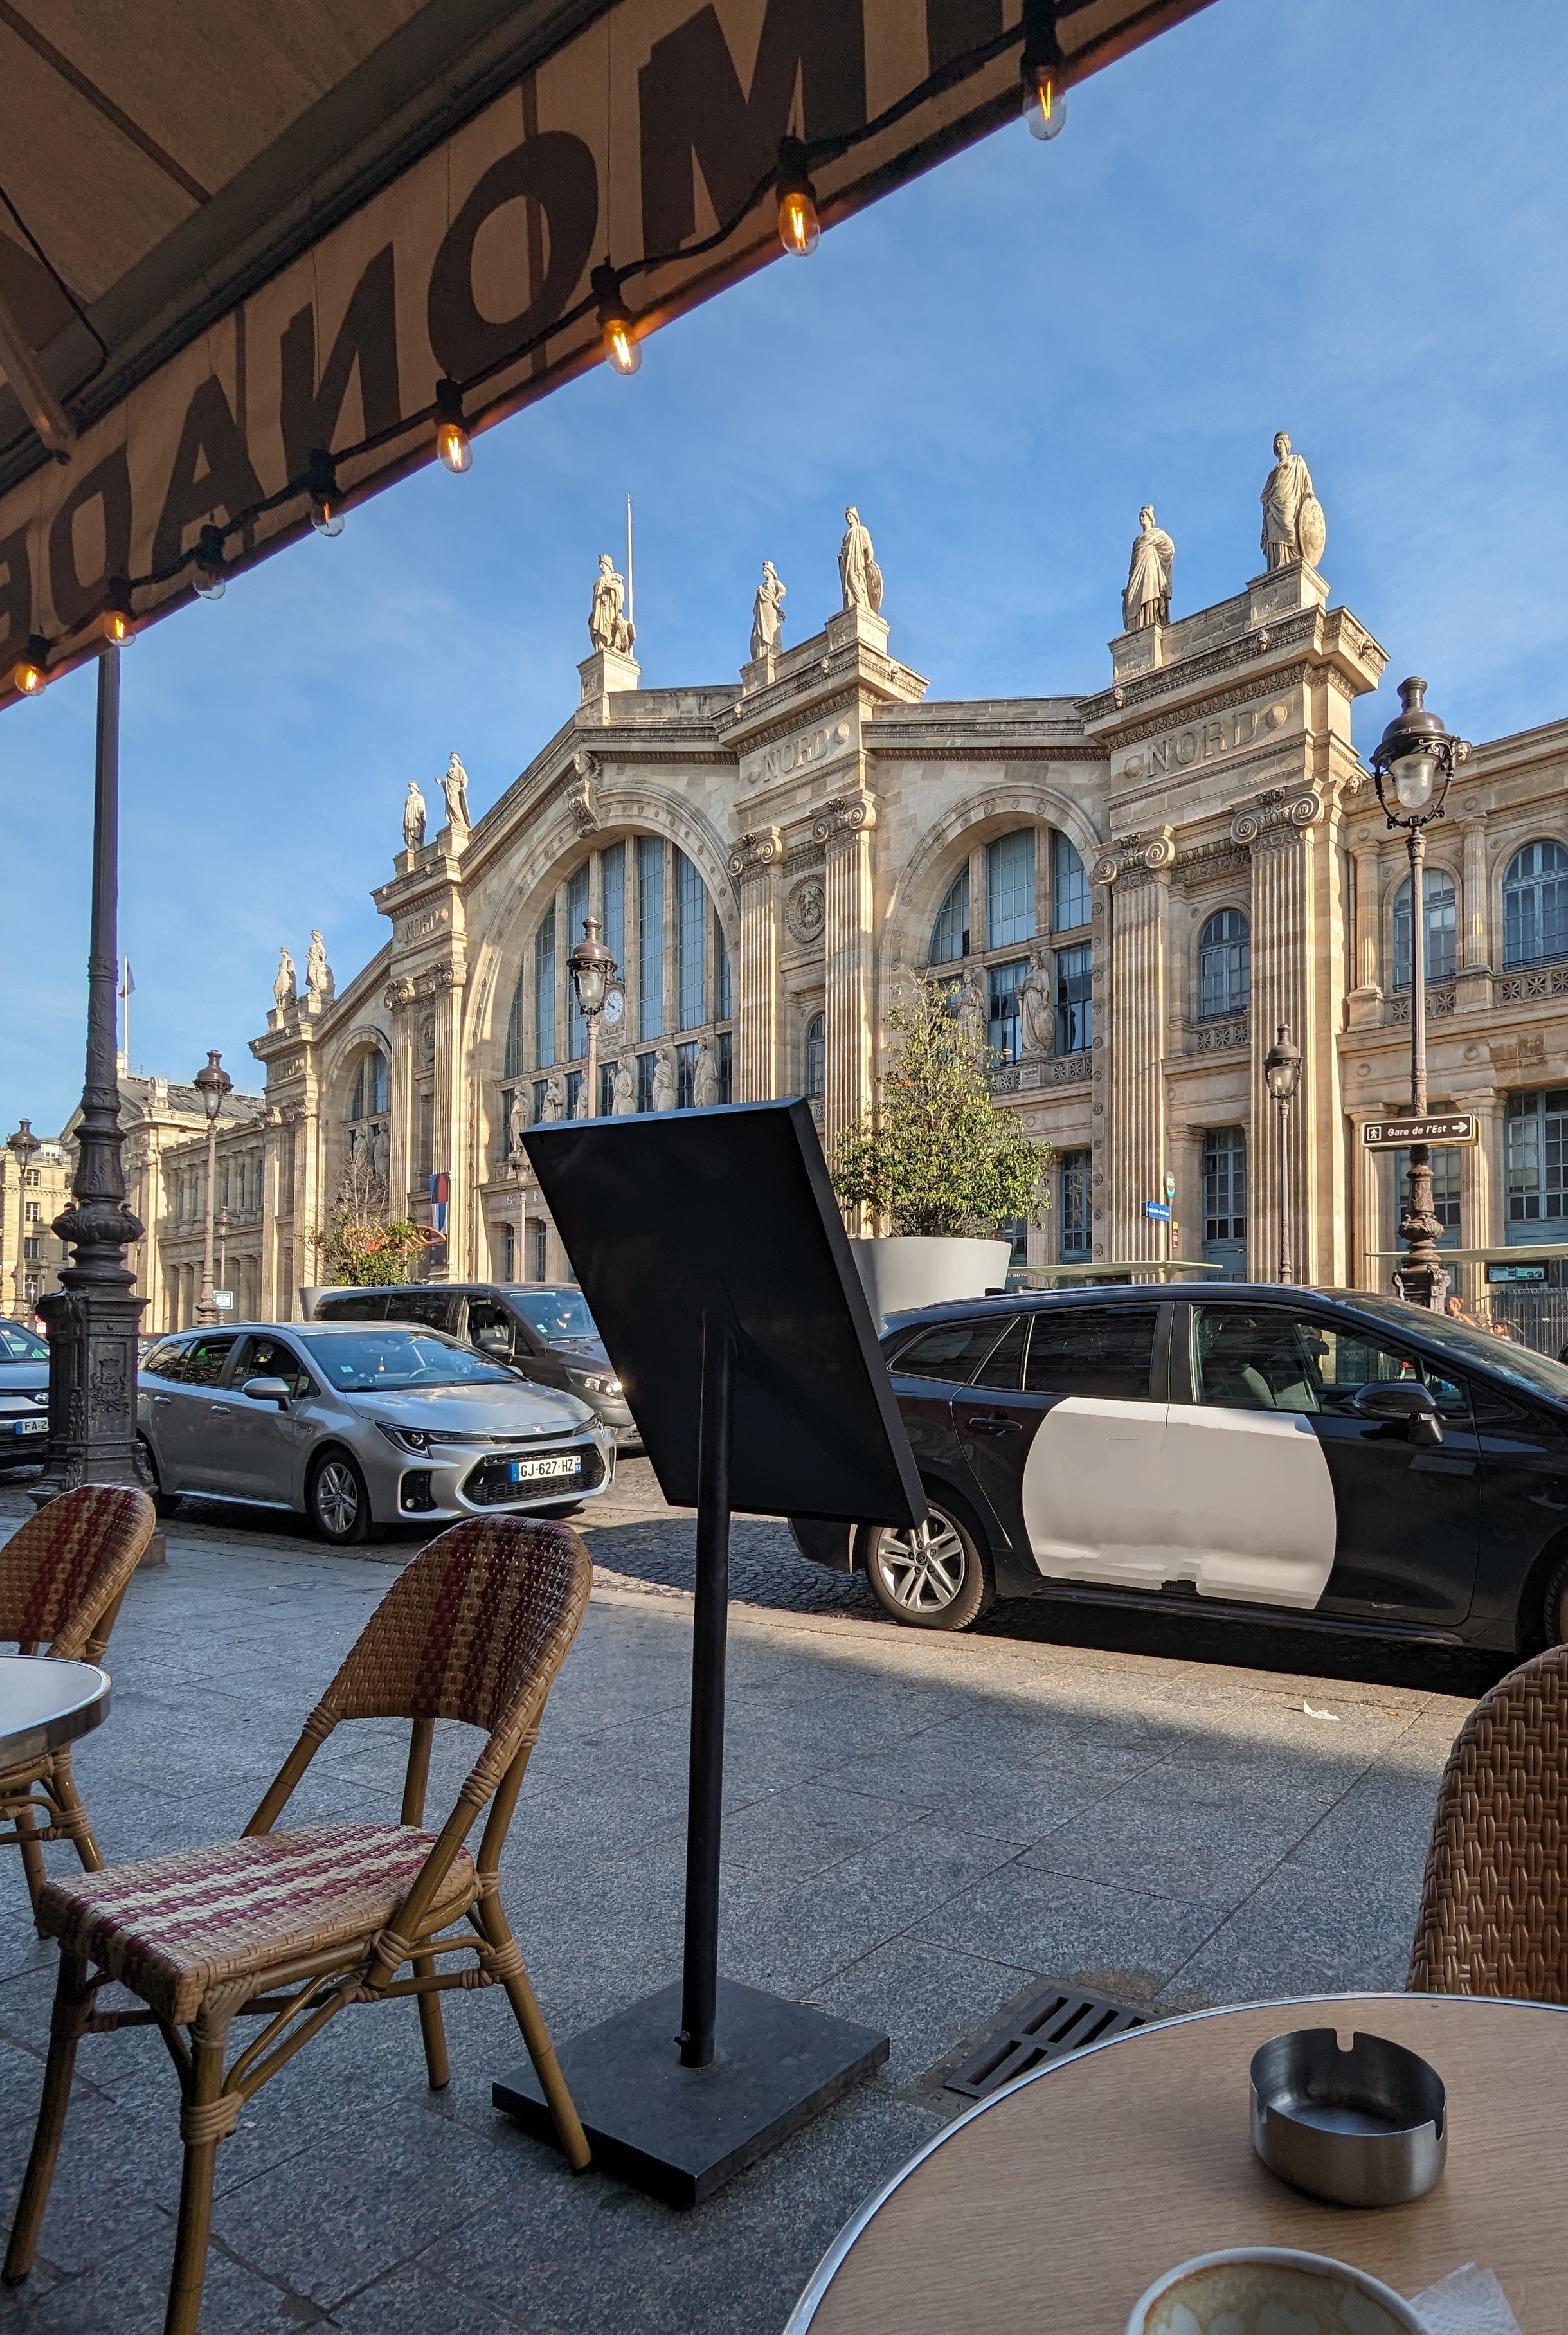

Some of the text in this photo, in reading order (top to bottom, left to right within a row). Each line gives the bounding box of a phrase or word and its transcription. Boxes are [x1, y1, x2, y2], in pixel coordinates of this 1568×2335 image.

[762, 728, 830, 782] NORD
[1147, 710, 1257, 779] NORD
[404, 909, 439, 944] NORD
[1387, 1124, 1446, 1137] Gare de l'Est
[24, 1420, 48, 1431] FA-2
[520, 1458, 574, 1477] GJ-627-HZ
